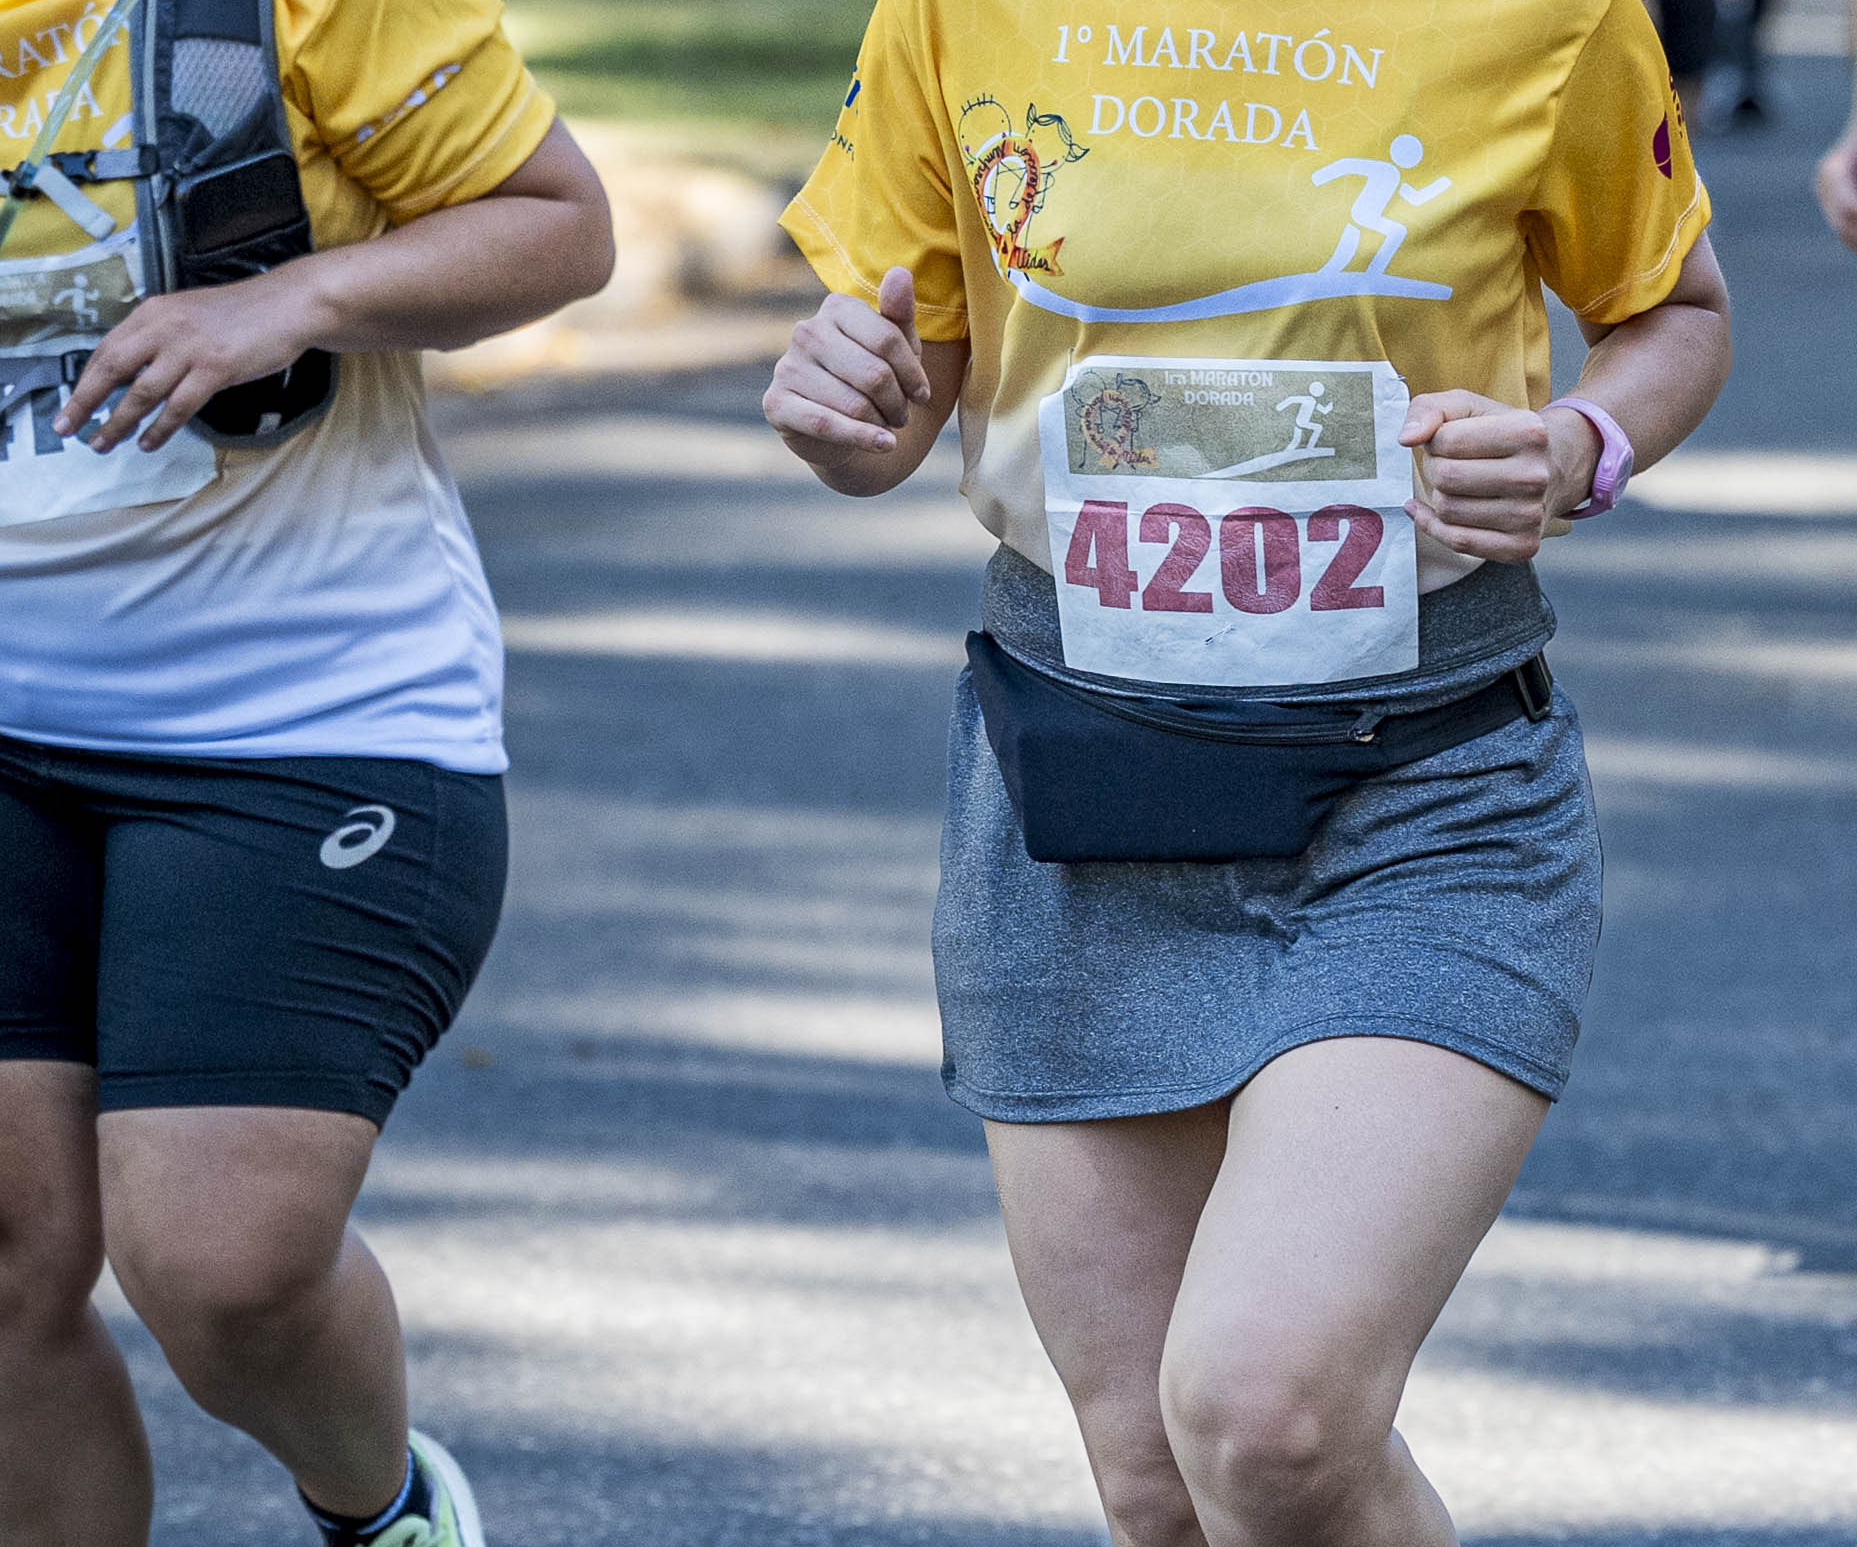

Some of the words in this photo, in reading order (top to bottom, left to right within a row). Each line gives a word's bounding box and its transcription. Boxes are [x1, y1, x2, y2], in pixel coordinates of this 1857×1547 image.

[1102, 24, 1385, 89] MARATÓN
[1088, 94, 1319, 151] DORADA
[1184, 390, 1255, 406] DORADA
[1064, 499, 1385, 615] 4202
